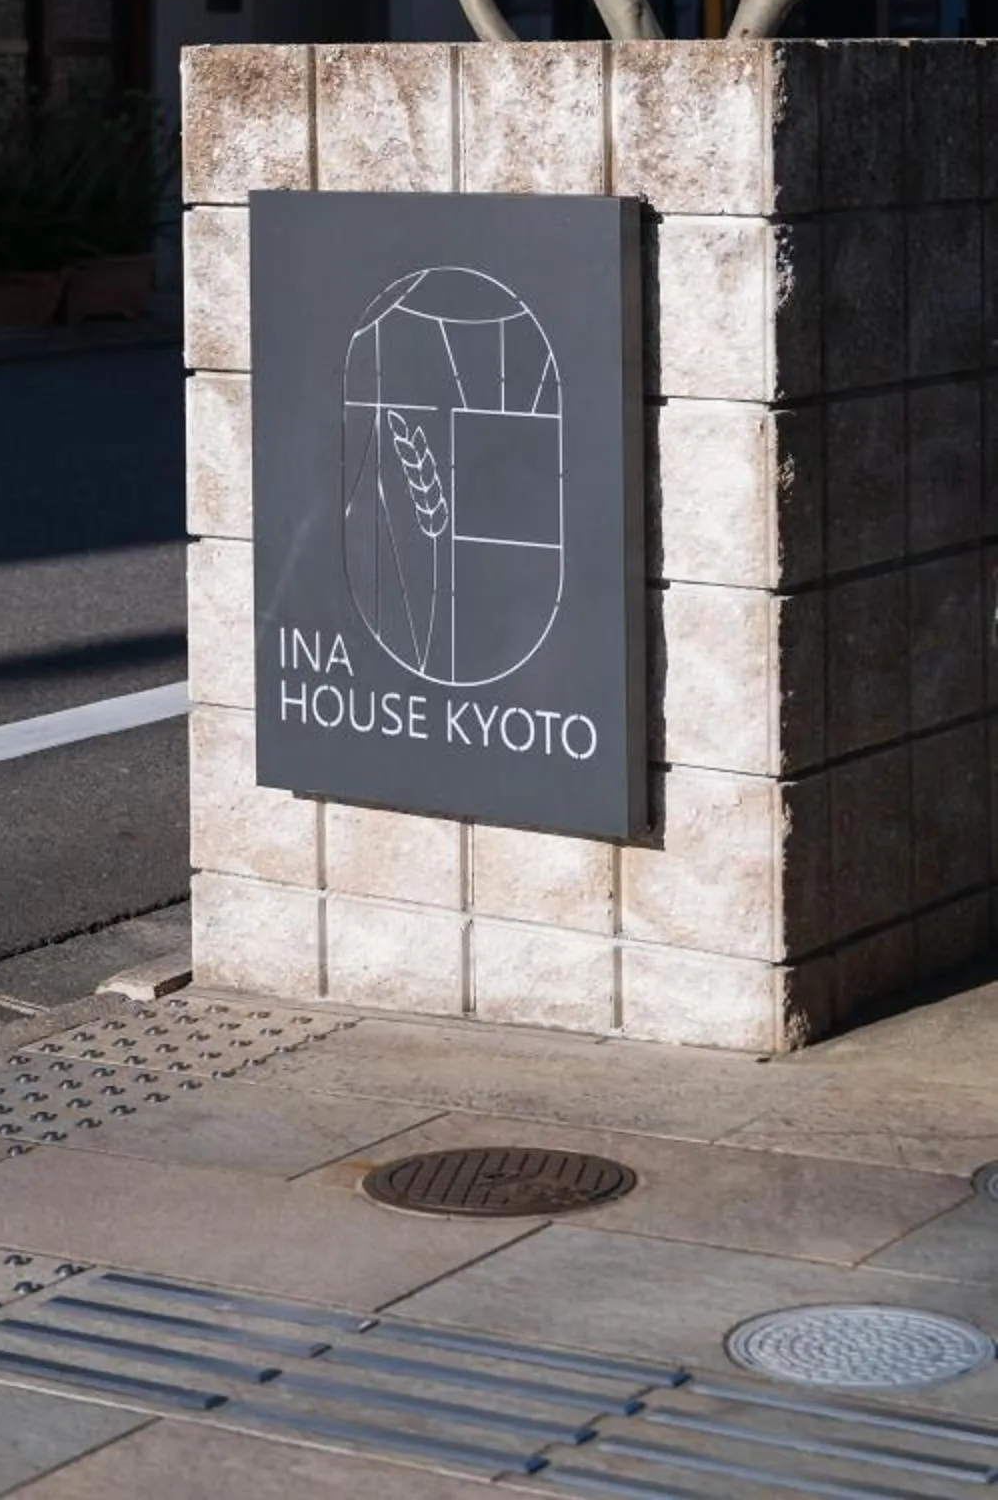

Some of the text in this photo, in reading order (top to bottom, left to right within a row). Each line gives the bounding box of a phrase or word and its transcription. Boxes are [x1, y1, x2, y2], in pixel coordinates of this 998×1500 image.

[280, 627, 354, 676] INA
[280, 680, 597, 760] HOUSE KYOTO
